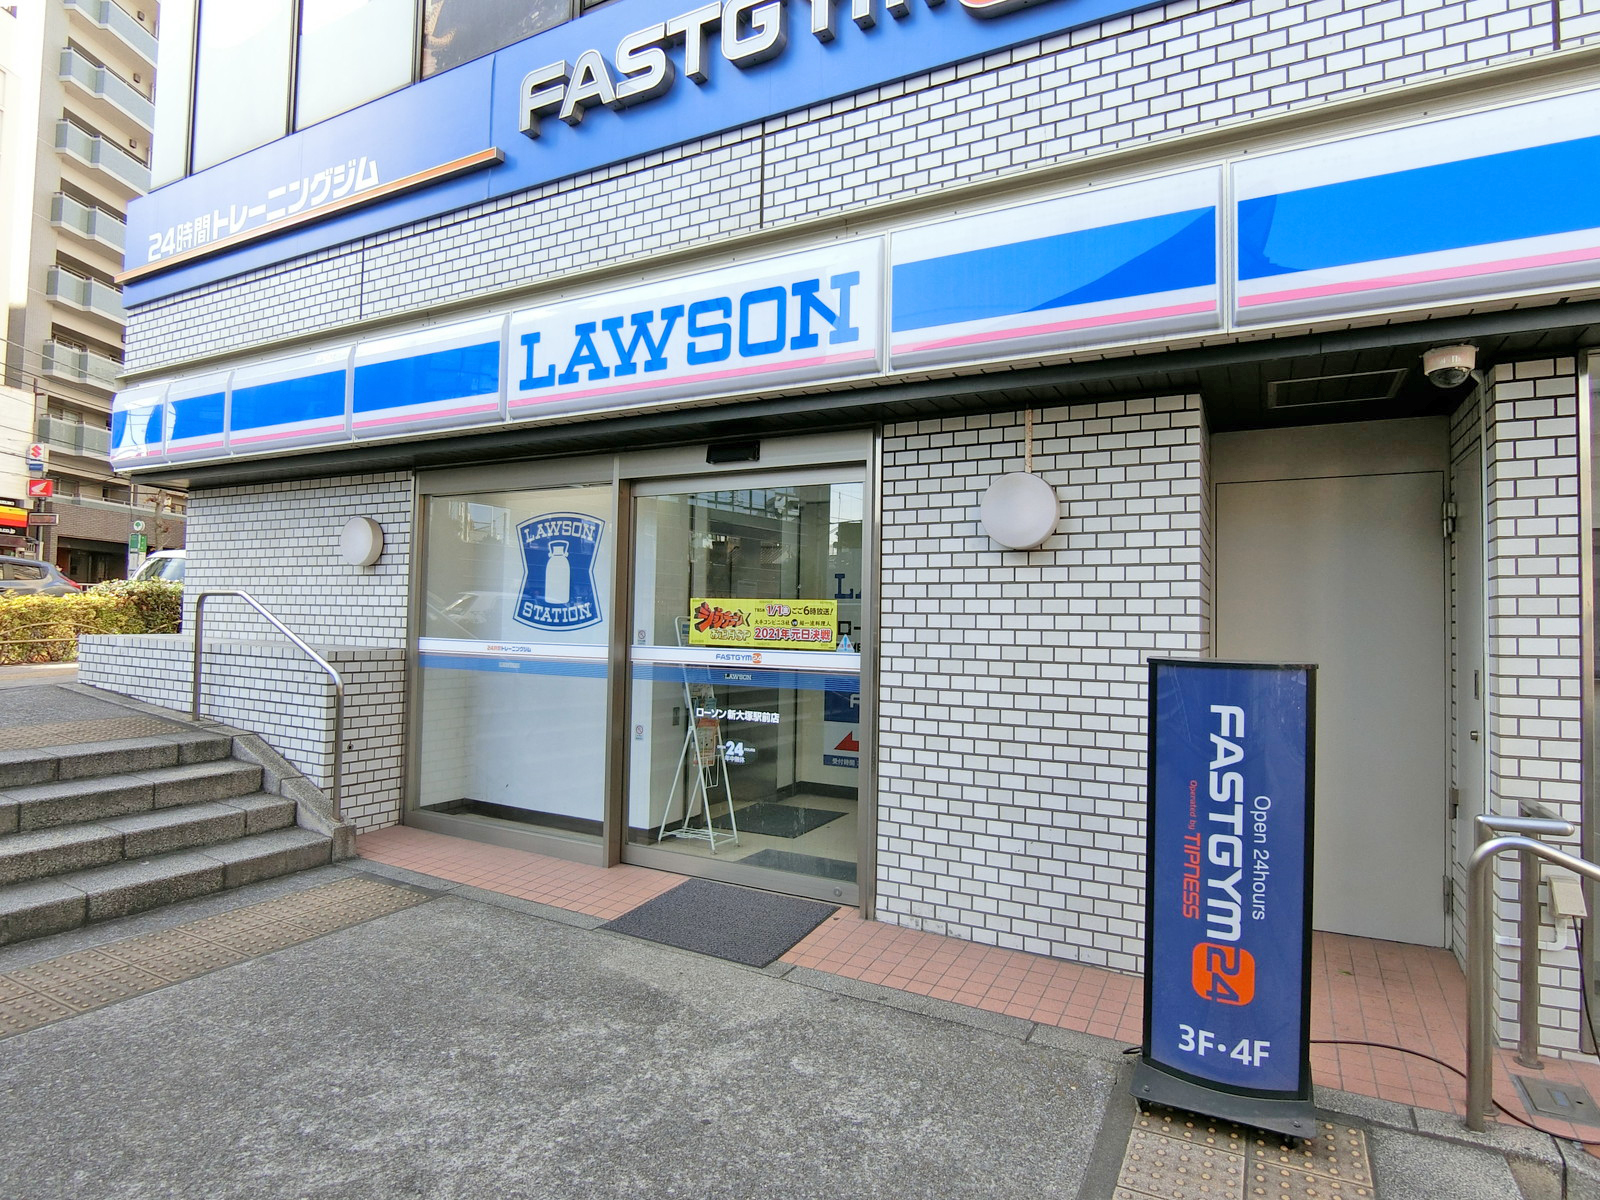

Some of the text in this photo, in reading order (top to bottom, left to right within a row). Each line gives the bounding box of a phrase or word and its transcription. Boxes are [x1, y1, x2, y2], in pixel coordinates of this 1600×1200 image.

[147, 157, 379, 262] 24時間トレーニングジム
[519, 270, 861, 392] LAWSON
[523, 520, 596, 544] LAWSON
[834, 573, 861, 600] L
[522, 602, 593, 624] STATION
[754, 627, 833, 642] 2021年元日決戦
[696, 707, 727, 719] ローソン
[725, 740, 744, 757] 24
[1188, 779, 1197, 821] Operated
[1187, 822, 1196, 831] by
[1250, 795, 1272, 921] Open 24hours
